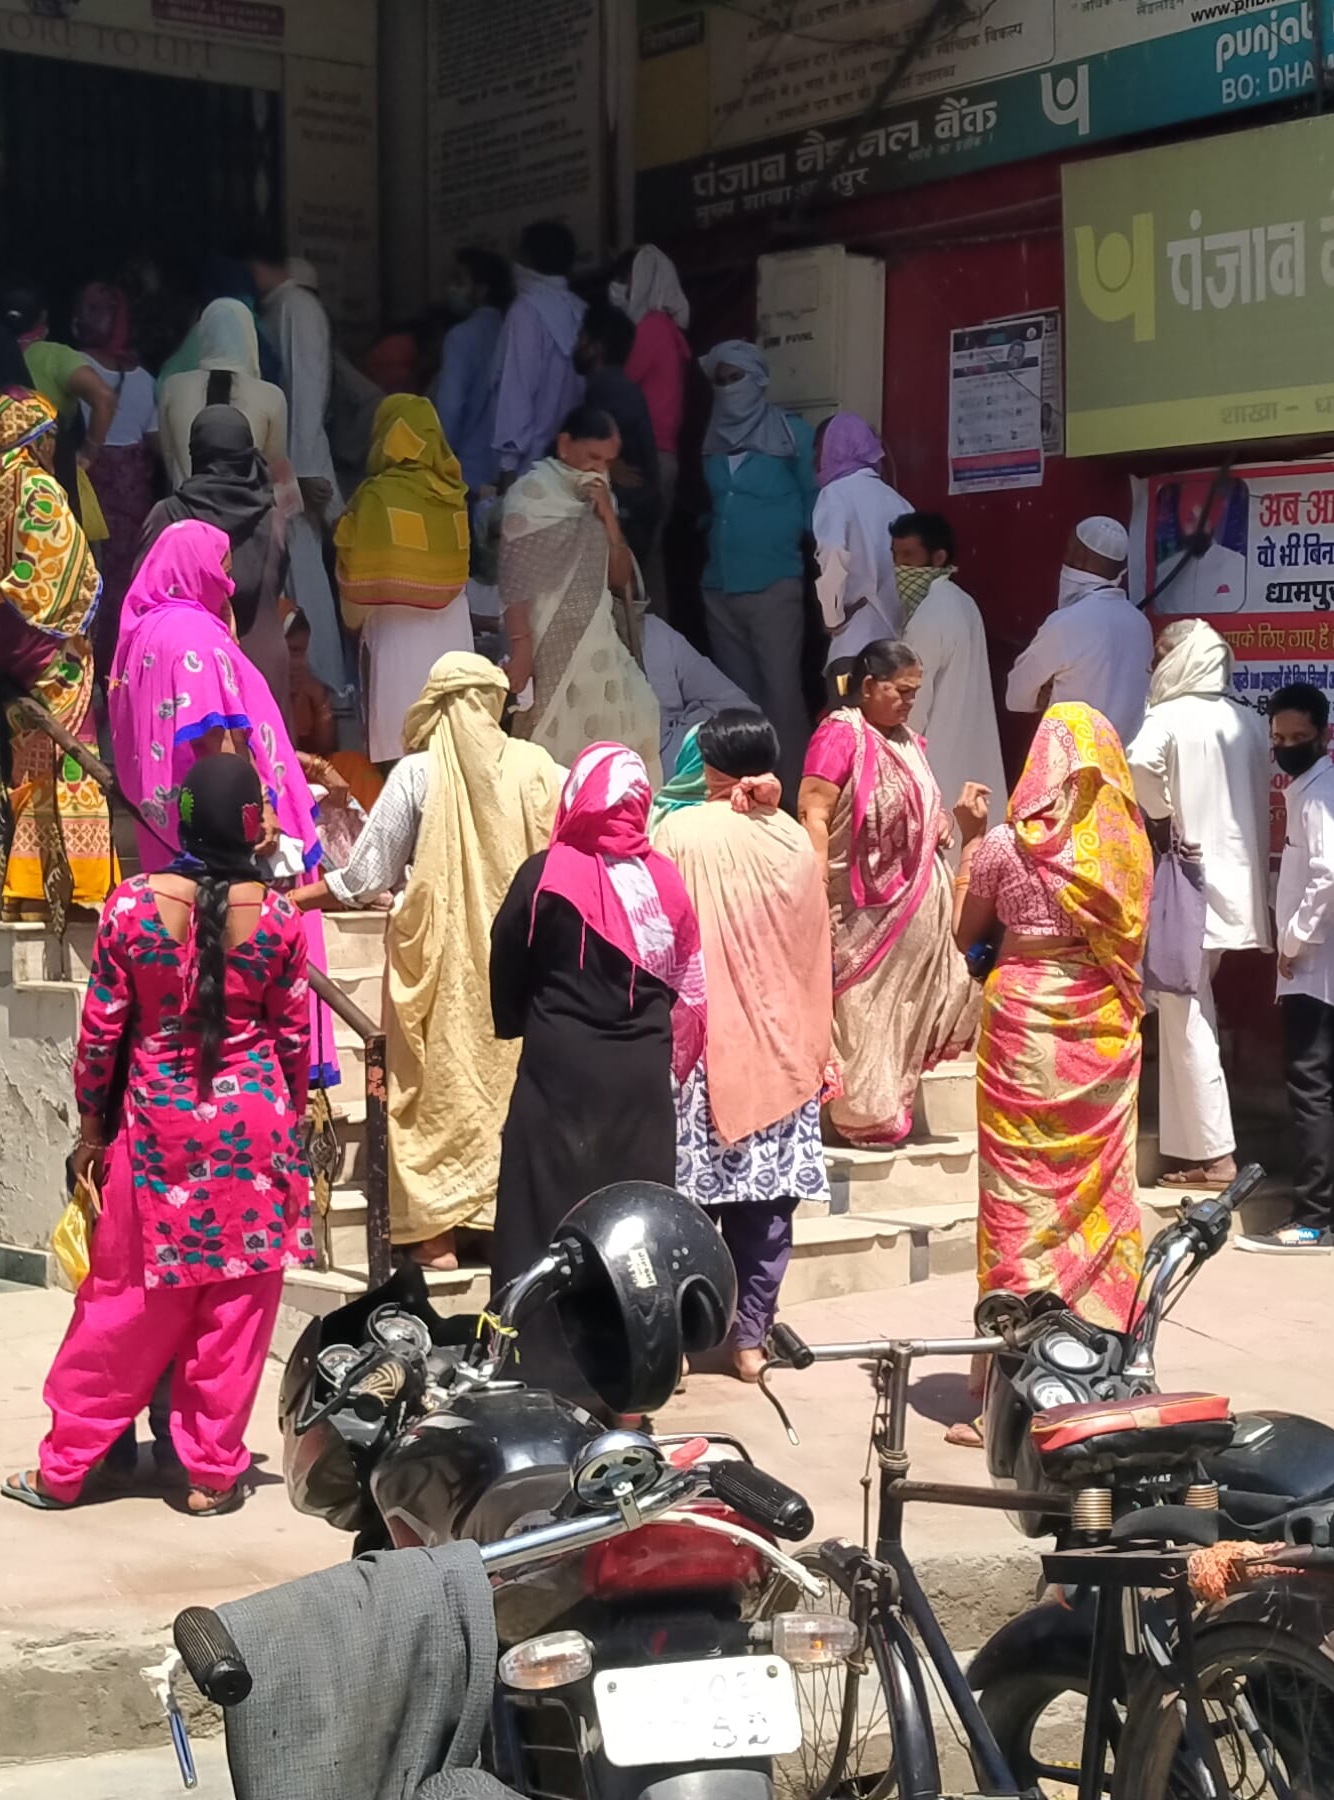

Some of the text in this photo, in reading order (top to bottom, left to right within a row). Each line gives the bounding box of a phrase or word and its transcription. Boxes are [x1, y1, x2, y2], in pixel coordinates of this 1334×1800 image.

[1190, 0, 1273, 23] www.pnb
[1221, 76, 1261, 104] BO:
[693, 154, 786, 198] पंजाब
[935, 96, 998, 140] बैंक
[1167, 208, 1306, 311] पंजाब
[1259, 489, 1300, 528] अब
[1257, 534, 1275, 569] वो
[1279, 531, 1301, 567] भी
[1257, 622, 1286, 653] लिए
